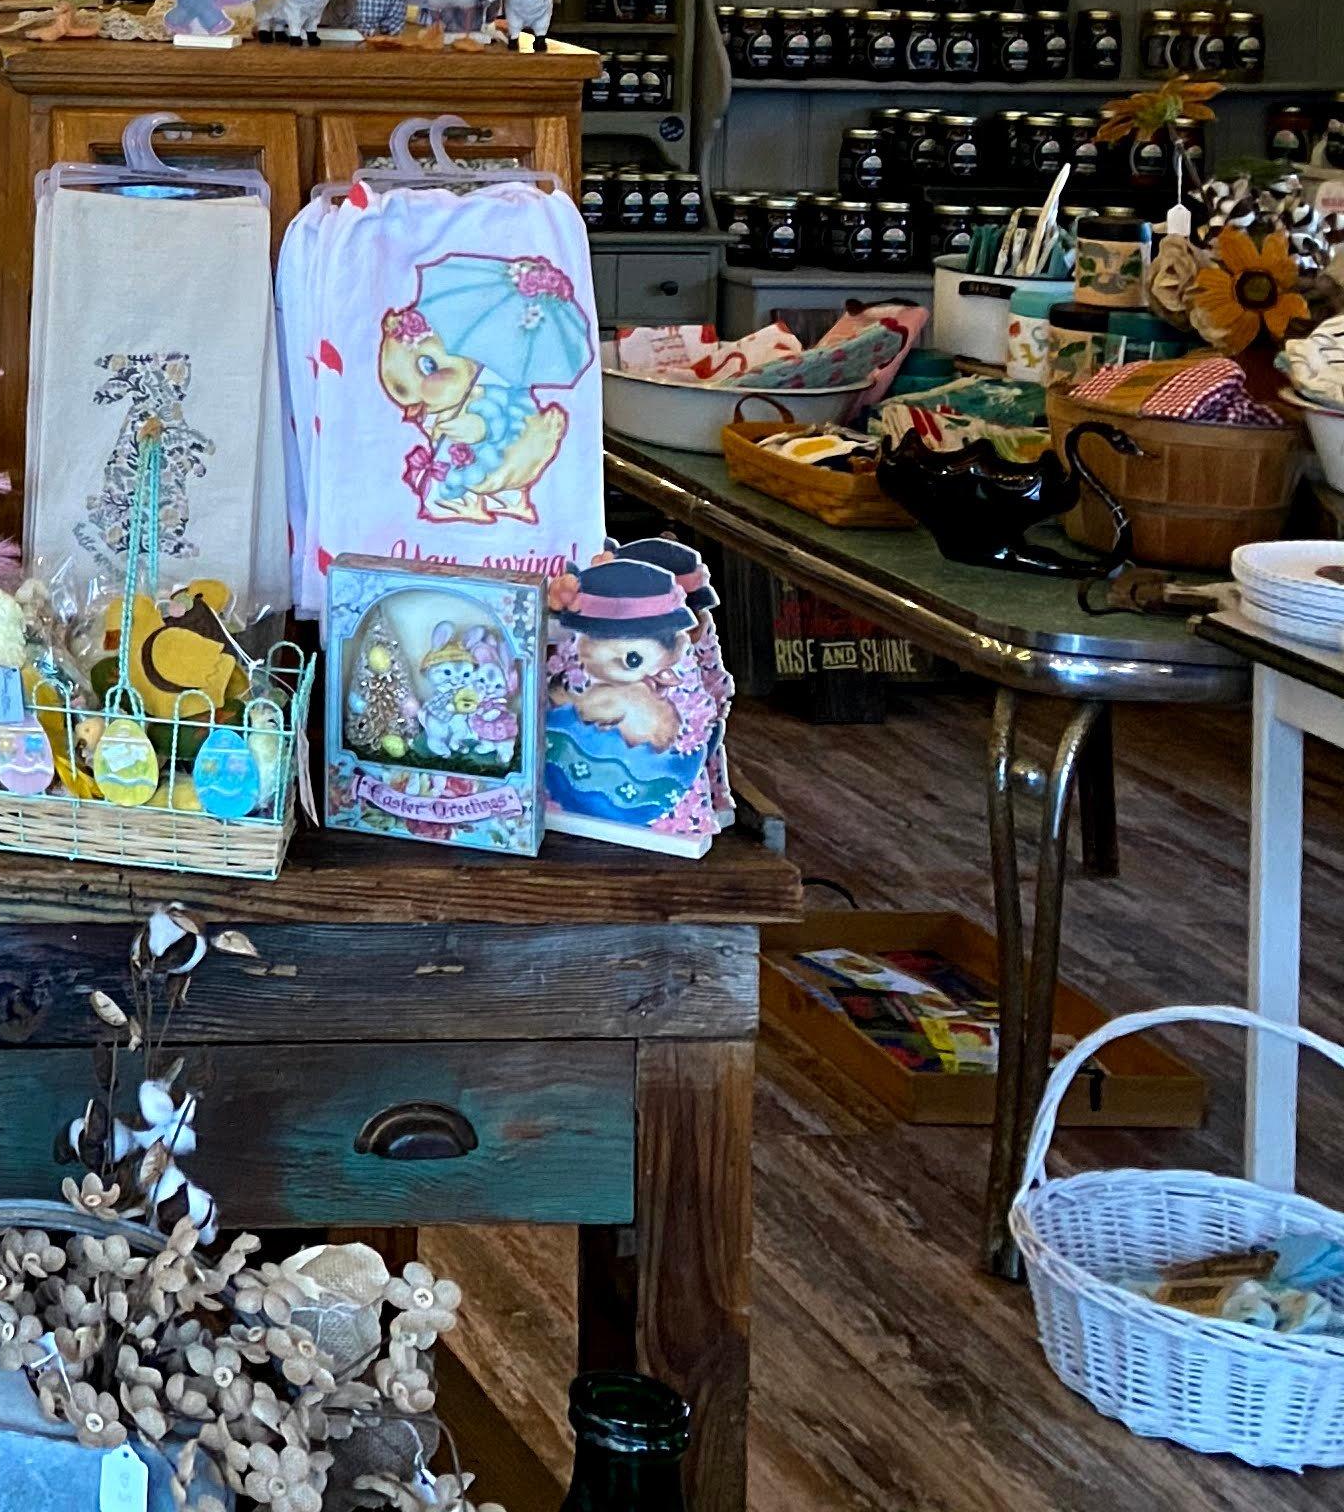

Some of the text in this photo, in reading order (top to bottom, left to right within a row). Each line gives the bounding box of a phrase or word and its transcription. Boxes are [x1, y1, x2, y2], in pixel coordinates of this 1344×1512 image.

[774, 638, 917, 674] RISE AND SHINE
[371, 783, 508, 818] Easter Greetings
